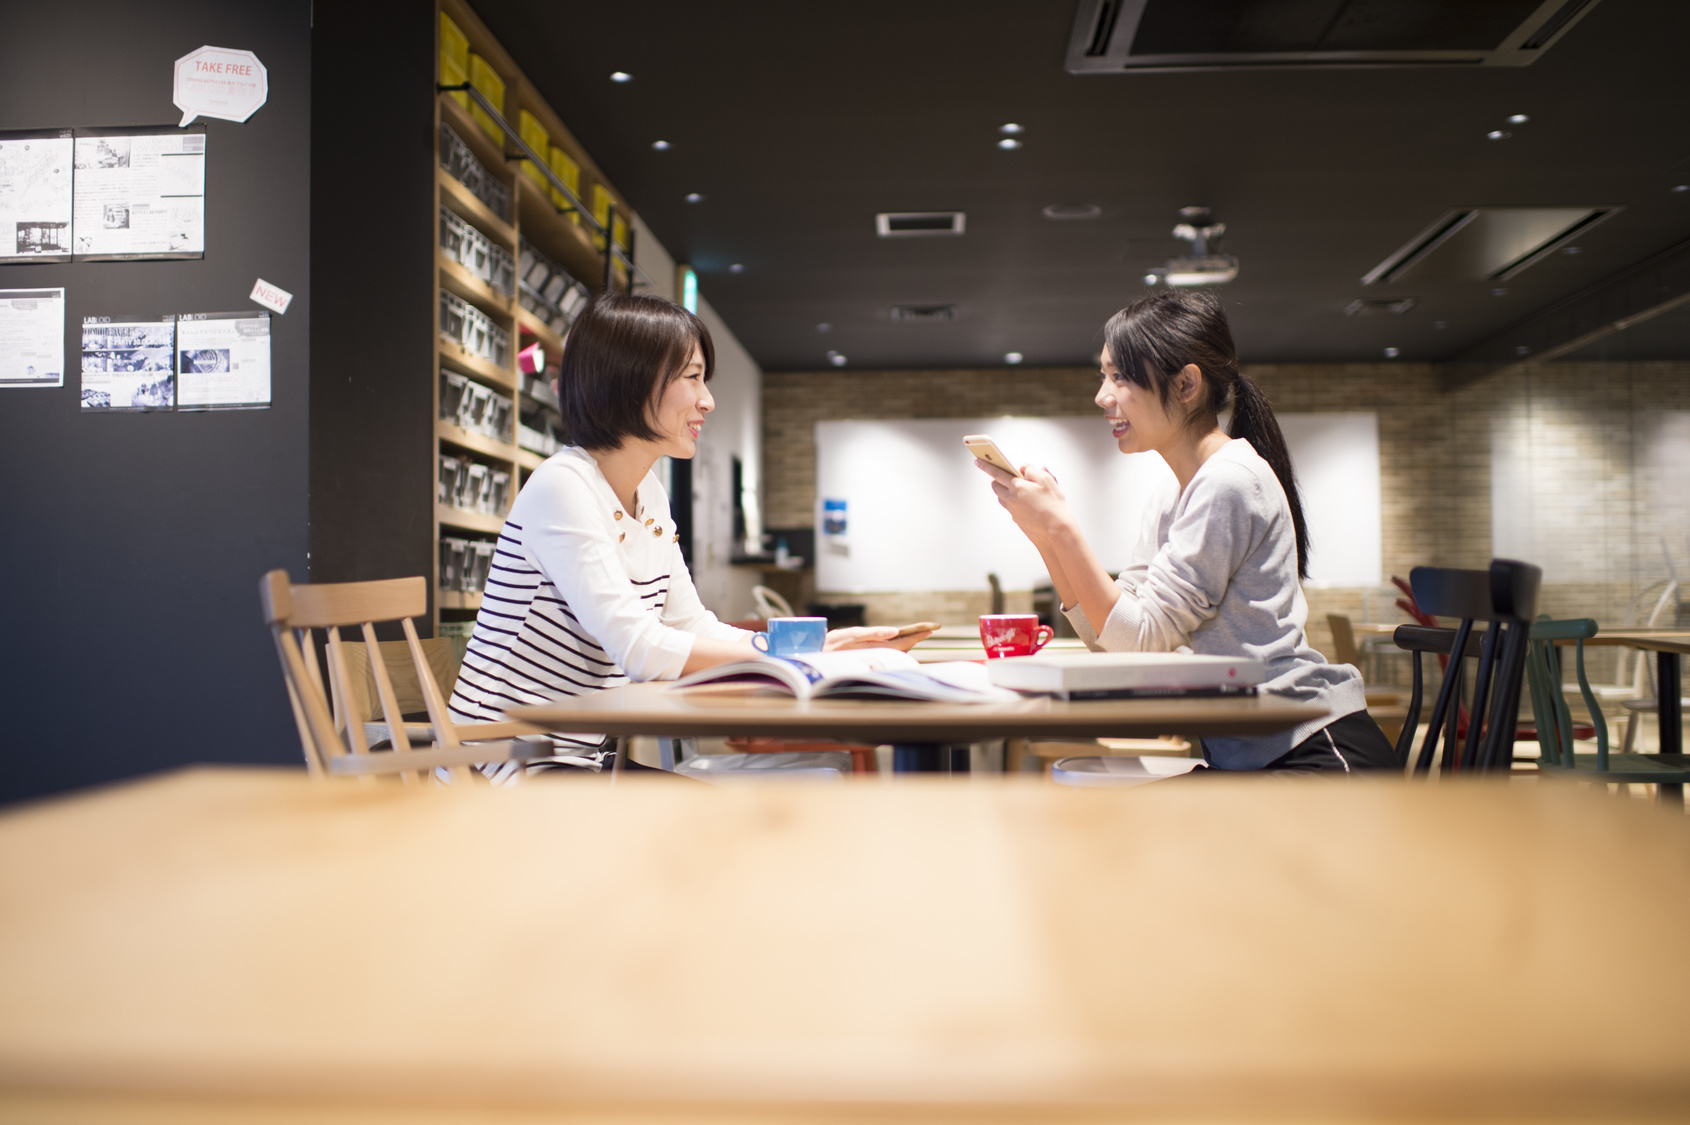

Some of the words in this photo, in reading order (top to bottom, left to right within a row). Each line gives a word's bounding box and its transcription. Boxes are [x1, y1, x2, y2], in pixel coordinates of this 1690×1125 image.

[195, 61, 223, 73] TAKE
[225, 63, 252, 76] FREE
[255, 286, 288, 307] NEW
[83, 316, 111, 324] LABLOID
[179, 313, 207, 321] LABLOID
